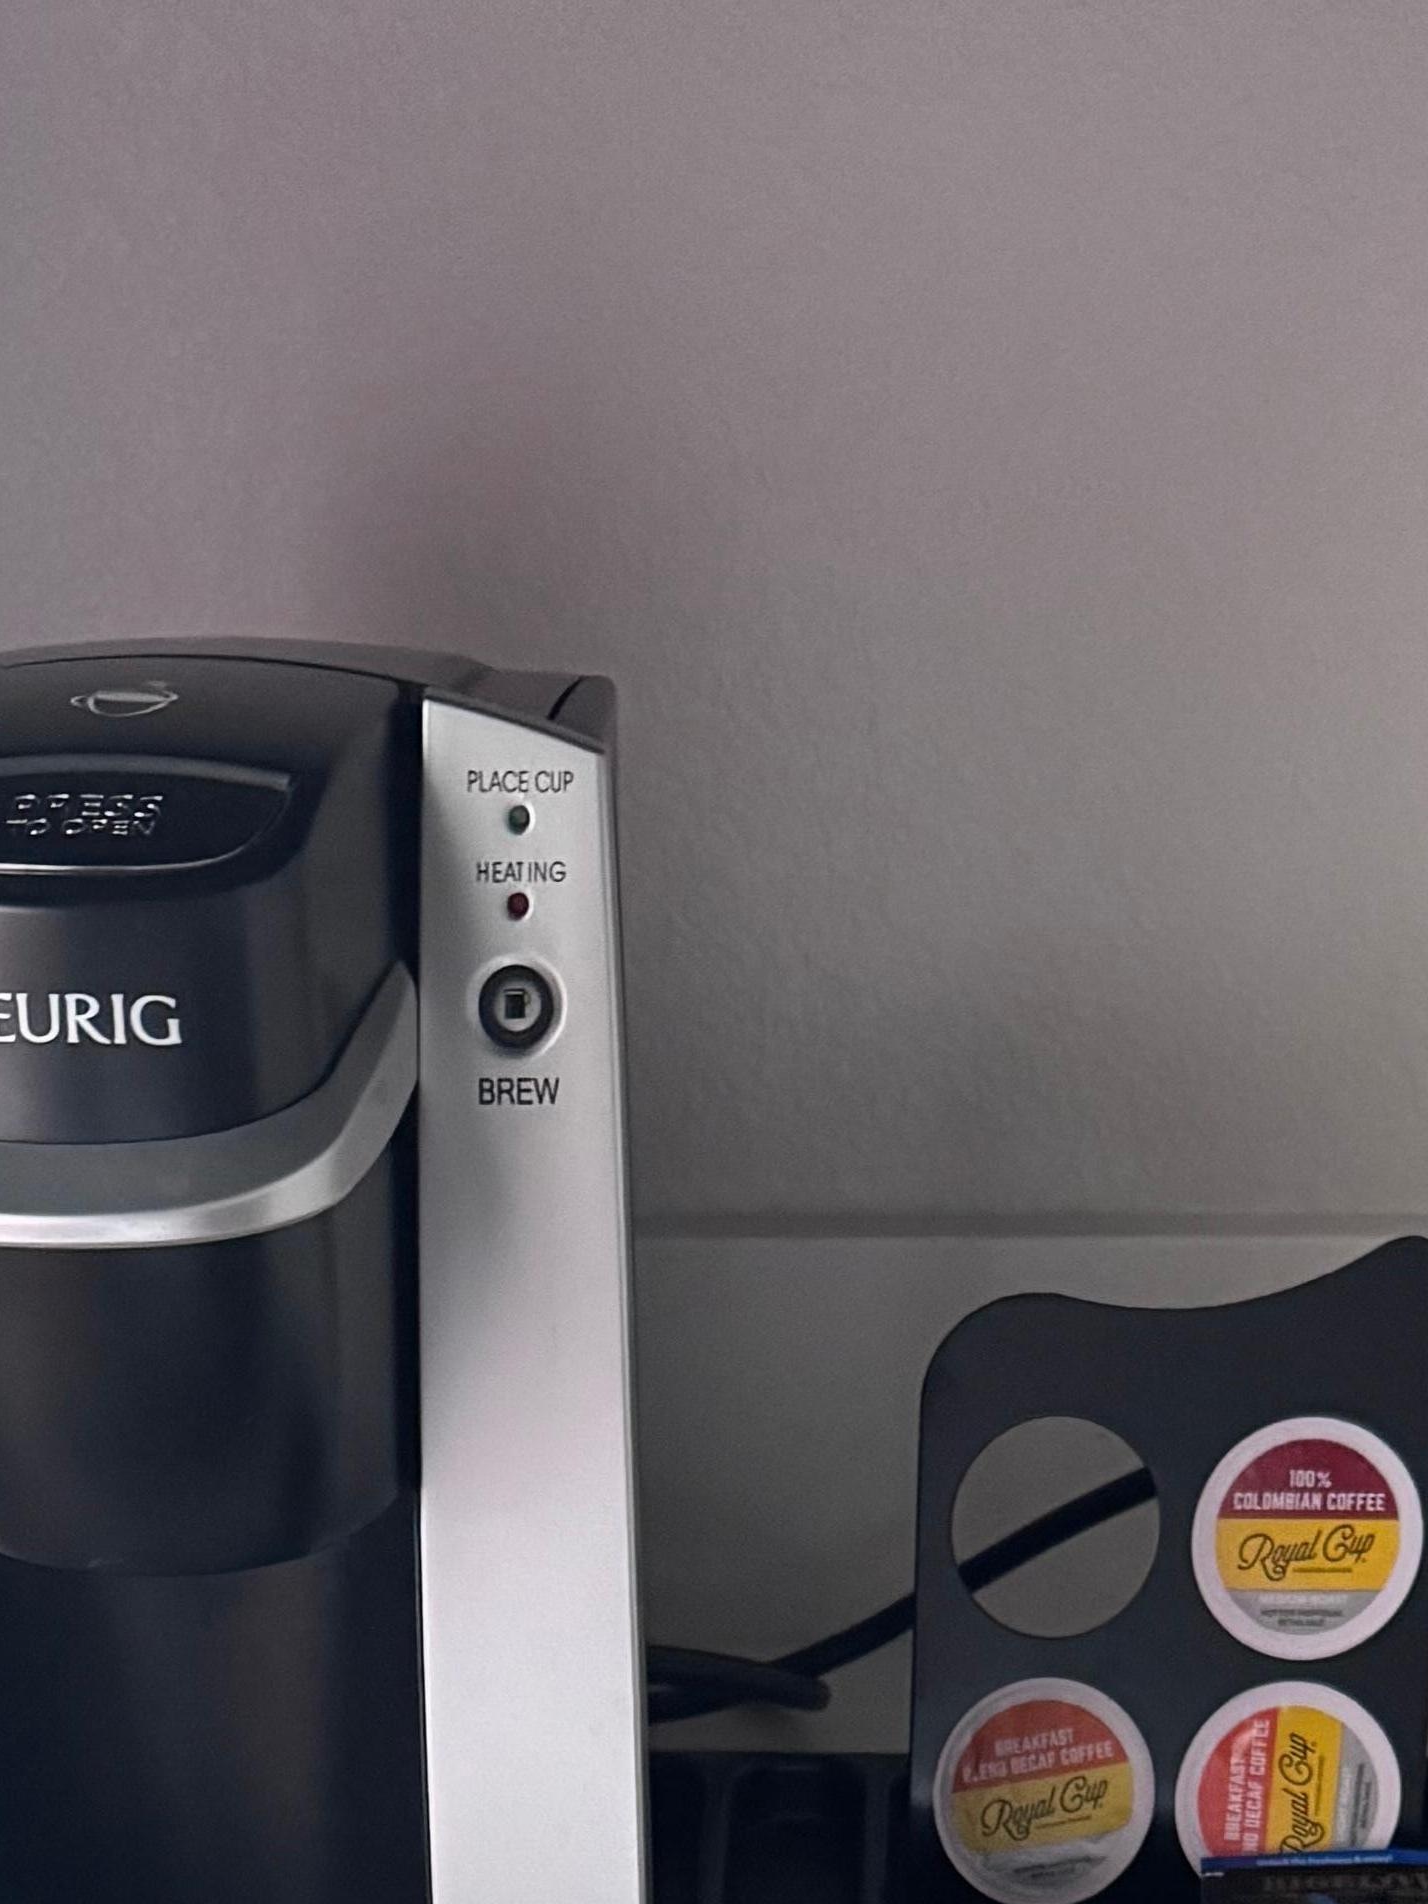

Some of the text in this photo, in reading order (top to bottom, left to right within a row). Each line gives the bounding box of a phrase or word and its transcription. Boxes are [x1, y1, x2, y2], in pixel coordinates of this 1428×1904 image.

[467, 770, 574, 793] PLACE CUP
[475, 861, 567, 883] HEATING
[478, 1077, 560, 1105] BREW
[1289, 1469, 1332, 1488] 100%
[1233, 1492, 1386, 1511] COLOMBIAN COFFEE
[1237, 1524, 1375, 1581] Royal Cup
[995, 1728, 1074, 1757] BREAKFAST
[1010, 1752, 1056, 1774] DECAF
[1060, 1740, 1114, 1766] COFFEE
[1278, 1732, 1317, 1786] Cup
[981, 1775, 1108, 1841] Royal Cup
